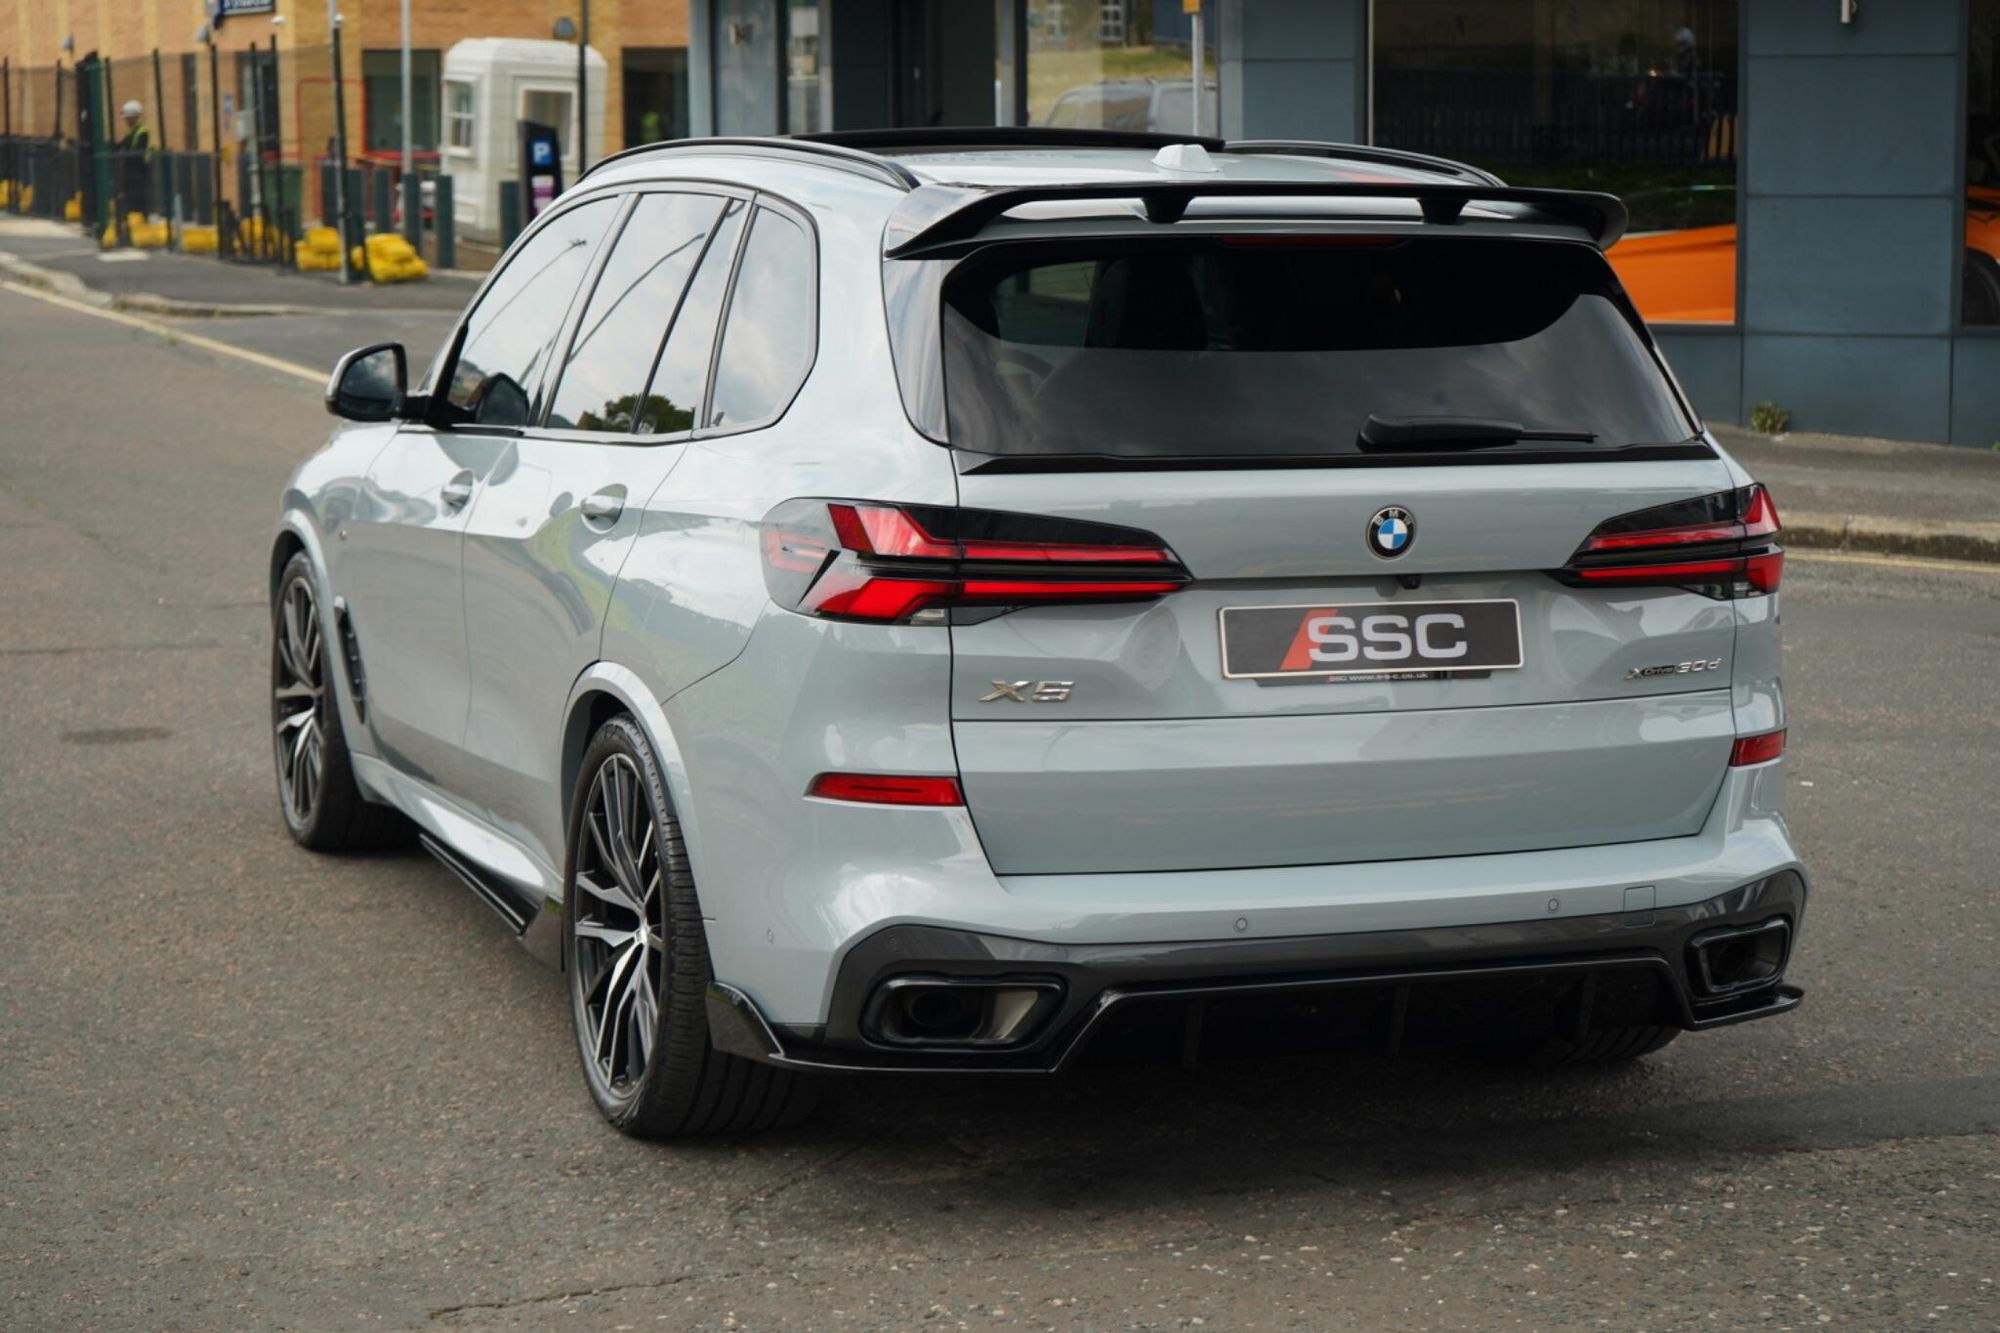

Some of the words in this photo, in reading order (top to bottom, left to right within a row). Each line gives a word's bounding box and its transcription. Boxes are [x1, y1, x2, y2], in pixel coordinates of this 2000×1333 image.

[533, 142, 551, 164] P
[1307, 613, 1468, 662] SSC
[977, 680, 1074, 702] X5
